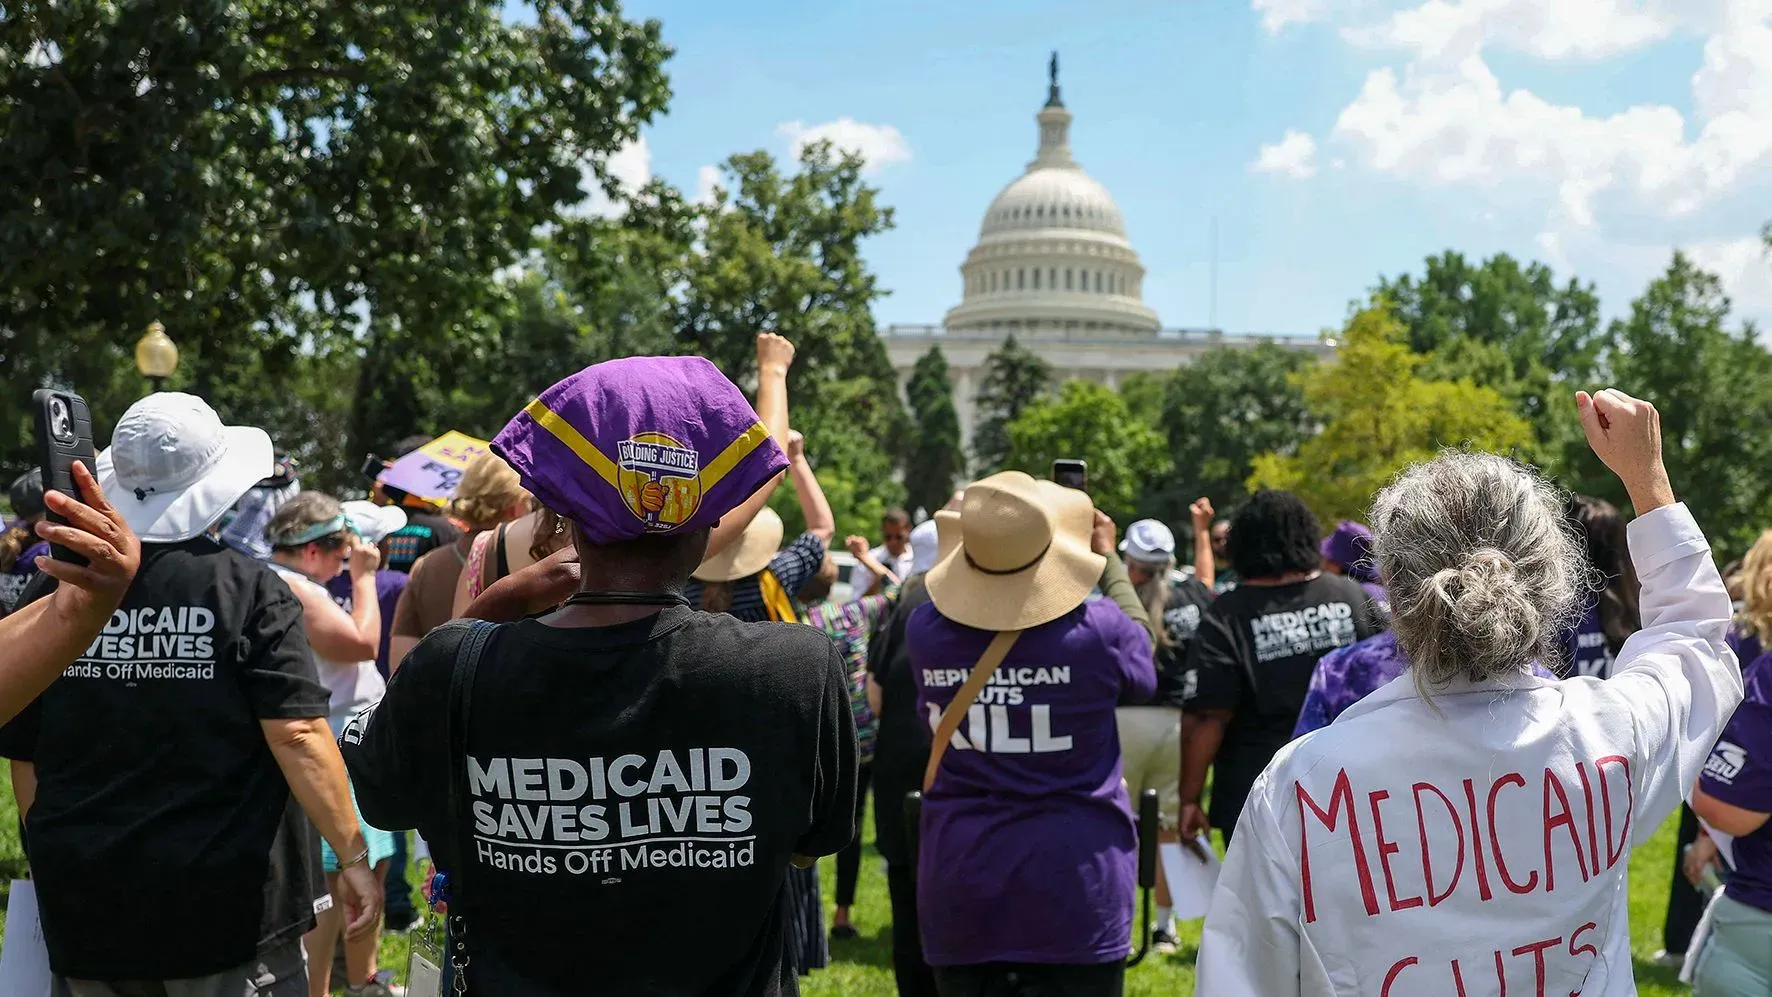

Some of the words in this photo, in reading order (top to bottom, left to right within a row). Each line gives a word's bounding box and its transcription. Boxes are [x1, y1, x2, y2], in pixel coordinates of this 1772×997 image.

[660, 450, 695, 469] JUSTICE
[101, 606, 215, 635] DICAID
[1250, 602, 1352, 636] MEDICAID
[83, 635, 135, 659] VES
[137, 635, 214, 659] LIVES
[63, 663, 101, 678] ands
[106, 664, 132, 679] Off
[136, 664, 214, 679] Medicaid
[922, 666, 1071, 687] REPLICAN
[974, 686, 1025, 705] UTS
[467, 748, 751, 801] MEDICAID
[473, 801, 610, 841] SAVES
[619, 795, 753, 838] LIVES
[1294, 755, 1634, 924] MEDICAID
[477, 841, 557, 874] Hands
[564, 849, 613, 875] Off
[620, 841, 754, 871] Medicaid
